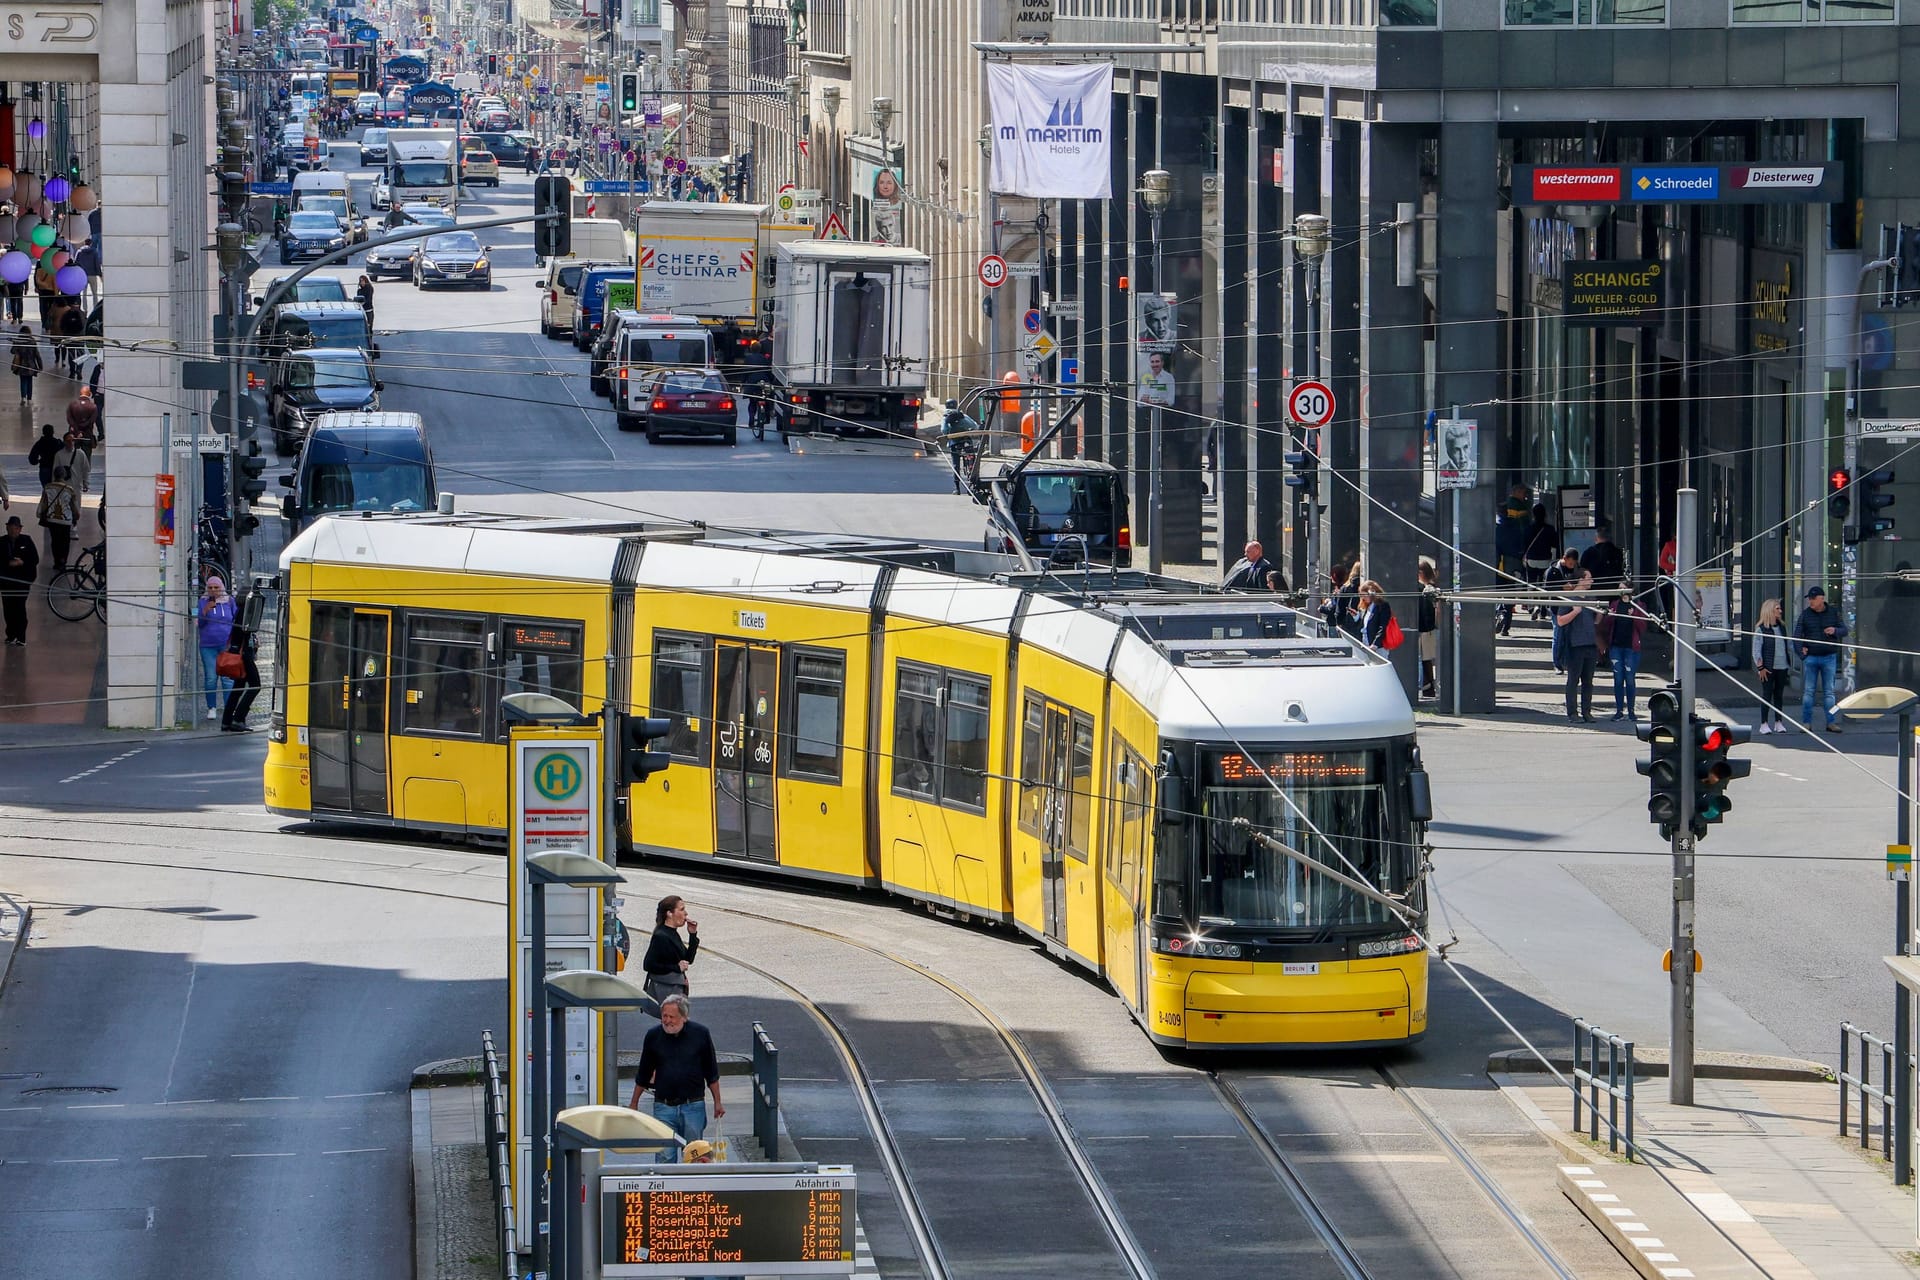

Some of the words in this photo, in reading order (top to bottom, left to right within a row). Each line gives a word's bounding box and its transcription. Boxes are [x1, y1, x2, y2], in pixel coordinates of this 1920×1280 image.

[389, 65, 420, 74] NORD-SÜD
[413, 94, 451, 104] NORD-SÜD
[1026, 128, 1102, 142] MARITIM
[1049, 145, 1080, 154] Hotels
[1539, 173, 1614, 185] westermann
[1654, 177, 1712, 190] Schroedel
[1752, 171, 1815, 184] Diesterweg
[657, 253, 720, 266] CHEFS
[657, 265, 737, 278] CULINAR
[984, 263, 1001, 278] 30
[1571, 294, 1623, 304] JUWELIER
[1628, 294, 1657, 304] GOLD
[1299, 394, 1325, 416] 30
[740, 611, 765, 629] Tickets
[1220, 755, 1243, 778] 12
[546, 764, 569, 790] H
[1158, 1010, 1182, 1027] B-4009
[618, 1182, 640, 1190] Linie
[648, 1181, 665, 1190] Ziel
[794, 1179, 829, 1188] Abfahrt
[832, 1179, 841, 1187] in
[625, 1192, 643, 1204] M1
[649, 1191, 715, 1203] Schillerstr.
[810, 1190, 815, 1201] 1
[819, 1189, 841, 1201] min
[626, 1204, 643, 1216] 12
[649, 1203, 729, 1216] Pasedagplatz
[808, 1201, 816, 1213] 5
[819, 1201, 841, 1213] min
[625, 1215, 643, 1227] M1
[649, 1215, 709, 1227] Rosenthal
[714, 1213, 742, 1226] Nord
[808, 1213, 816, 1225] 9
[819, 1213, 841, 1225] min
[626, 1227, 643, 1239] 12
[649, 1226, 729, 1239] Pasedagplatz
[802, 1225, 816, 1236] 15
[819, 1225, 841, 1236] min
[625, 1239, 642, 1251] M1
[649, 1238, 715, 1250] Schillerstr.
[802, 1237, 816, 1248] 16
[819, 1237, 841, 1248] min
[625, 1250, 643, 1263] M
[649, 1250, 709, 1262] Rosenthal
[714, 1249, 742, 1261] Nord
[802, 1248, 816, 1260] 24
[819, 1248, 841, 1260] min
